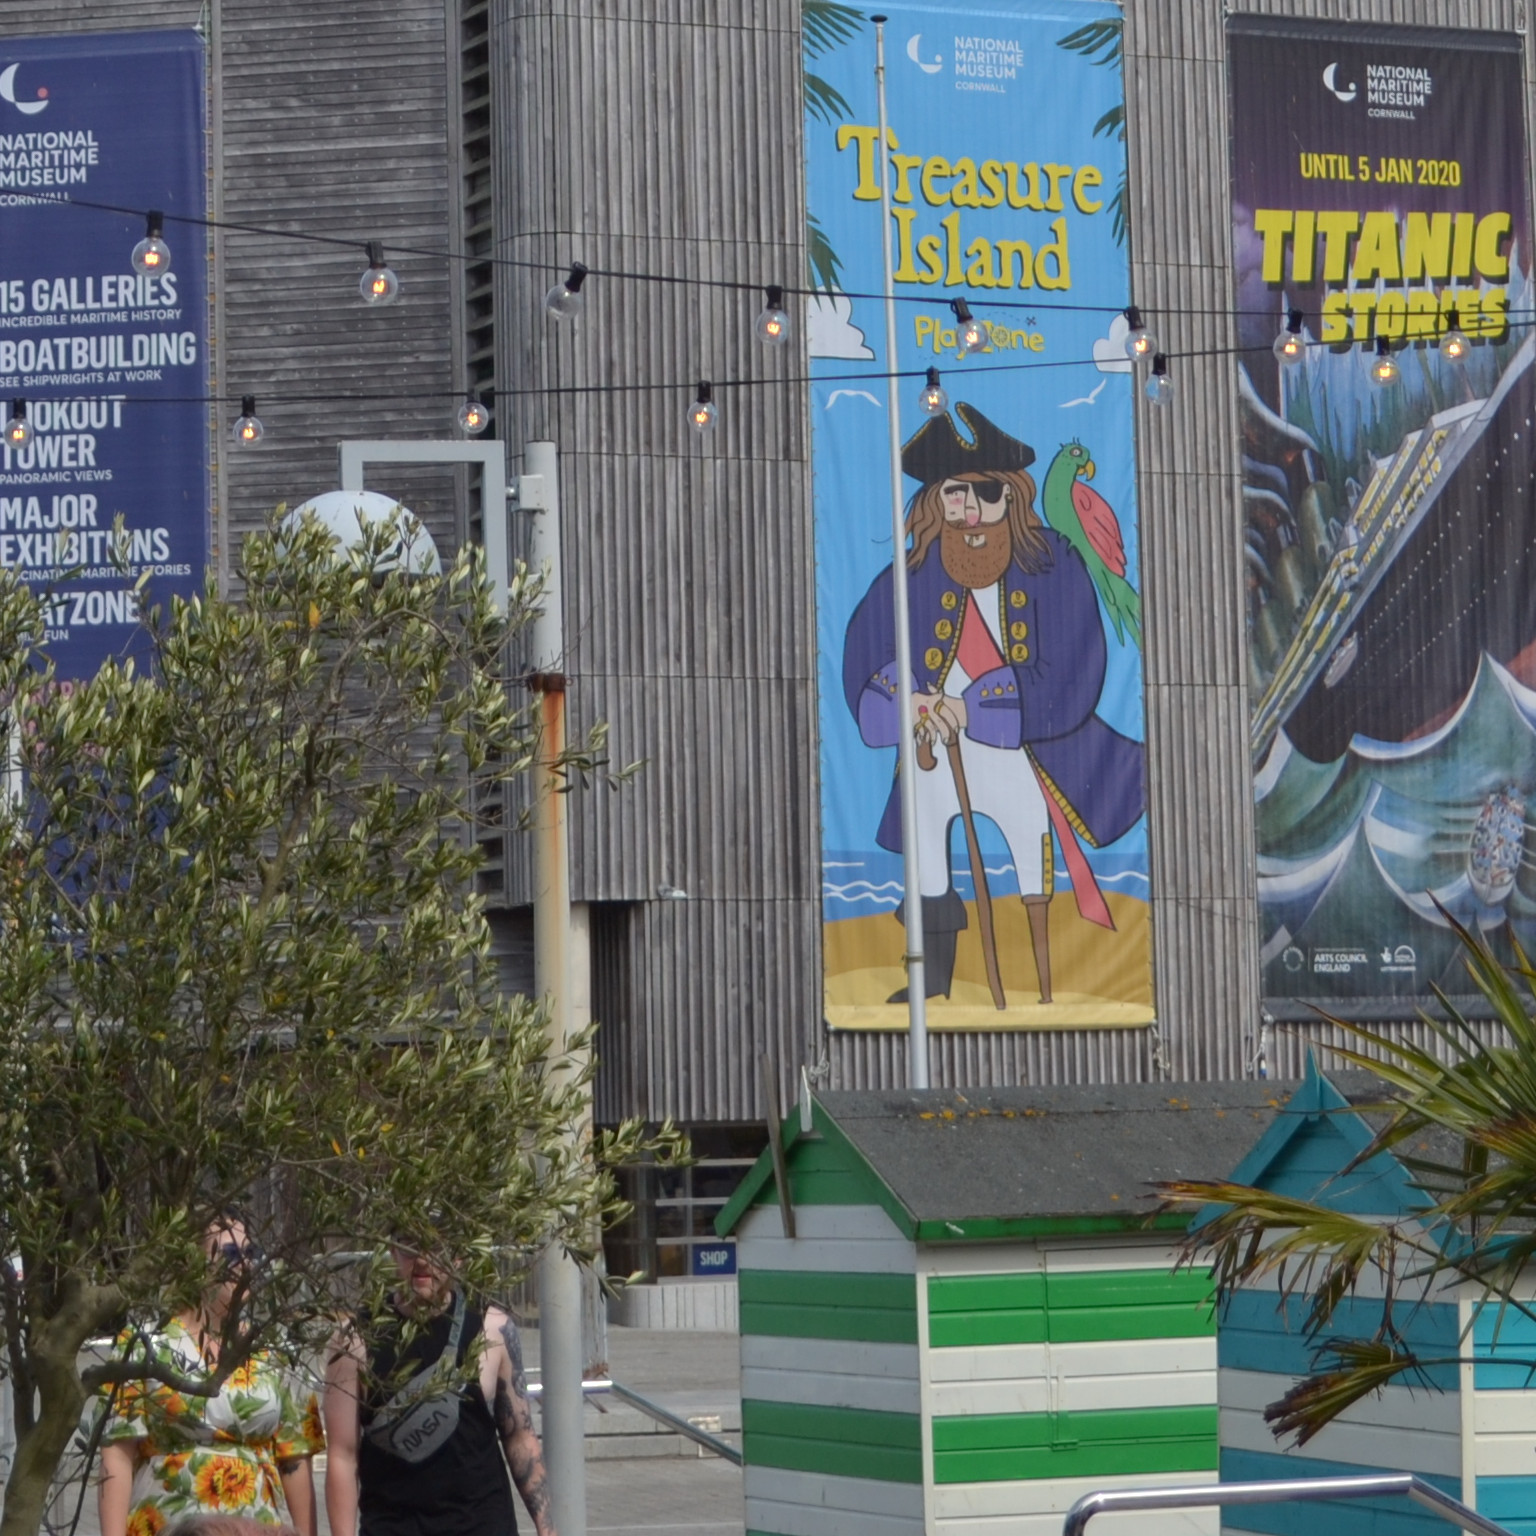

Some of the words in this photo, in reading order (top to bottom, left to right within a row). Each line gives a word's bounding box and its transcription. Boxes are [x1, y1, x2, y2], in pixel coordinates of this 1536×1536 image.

[954, 36, 1023, 53] NATIONAL
[954, 50, 1024, 66] MARITIME
[955, 63, 1017, 79] MUSEUM
[1367, 64, 1431, 80] NATIONAL
[955, 80, 1006, 93] CORNWALL
[1367, 77, 1432, 94] MARITIME
[1367, 90, 1425, 106] MUSEUM
[1367, 107, 1415, 120] CORNWALL
[836, 124, 1103, 214] Treasure
[1300, 152, 1355, 180] UNTIL
[1359, 156, 1370, 182] 5
[1375, 158, 1413, 184] JAN
[1417, 159, 1461, 187] 2020
[891, 207, 1072, 291] Island
[1254, 209, 1511, 284] TITANIC
[31, 272, 178, 312] GALLERIES
[70, 311, 129, 324] MARITIME
[131, 308, 182, 322] HISTORY
[1321, 288, 1508, 344] STORIES
[915, 315, 1045, 360] Plaone
[22, 372, 105, 386] SHIPWRIGHTS
[107, 371, 122, 383] AT
[125, 369, 162, 382] WORK
[74, 469, 113, 482] VIEWS
[0, 494, 97, 530] MAJOR
[81, 566, 139, 579] MARITE
[38, 590, 141, 626] AYZONE
[44, 629, 69, 641] FUN
[1314, 953, 1334, 963] ARTS
[1335, 953, 1368, 963] COUNCIL
[1314, 963, 1351, 973] ENGLAND
[700, 1251, 728, 1266] SHOP
[402, 1410, 448, 1452] NASA
